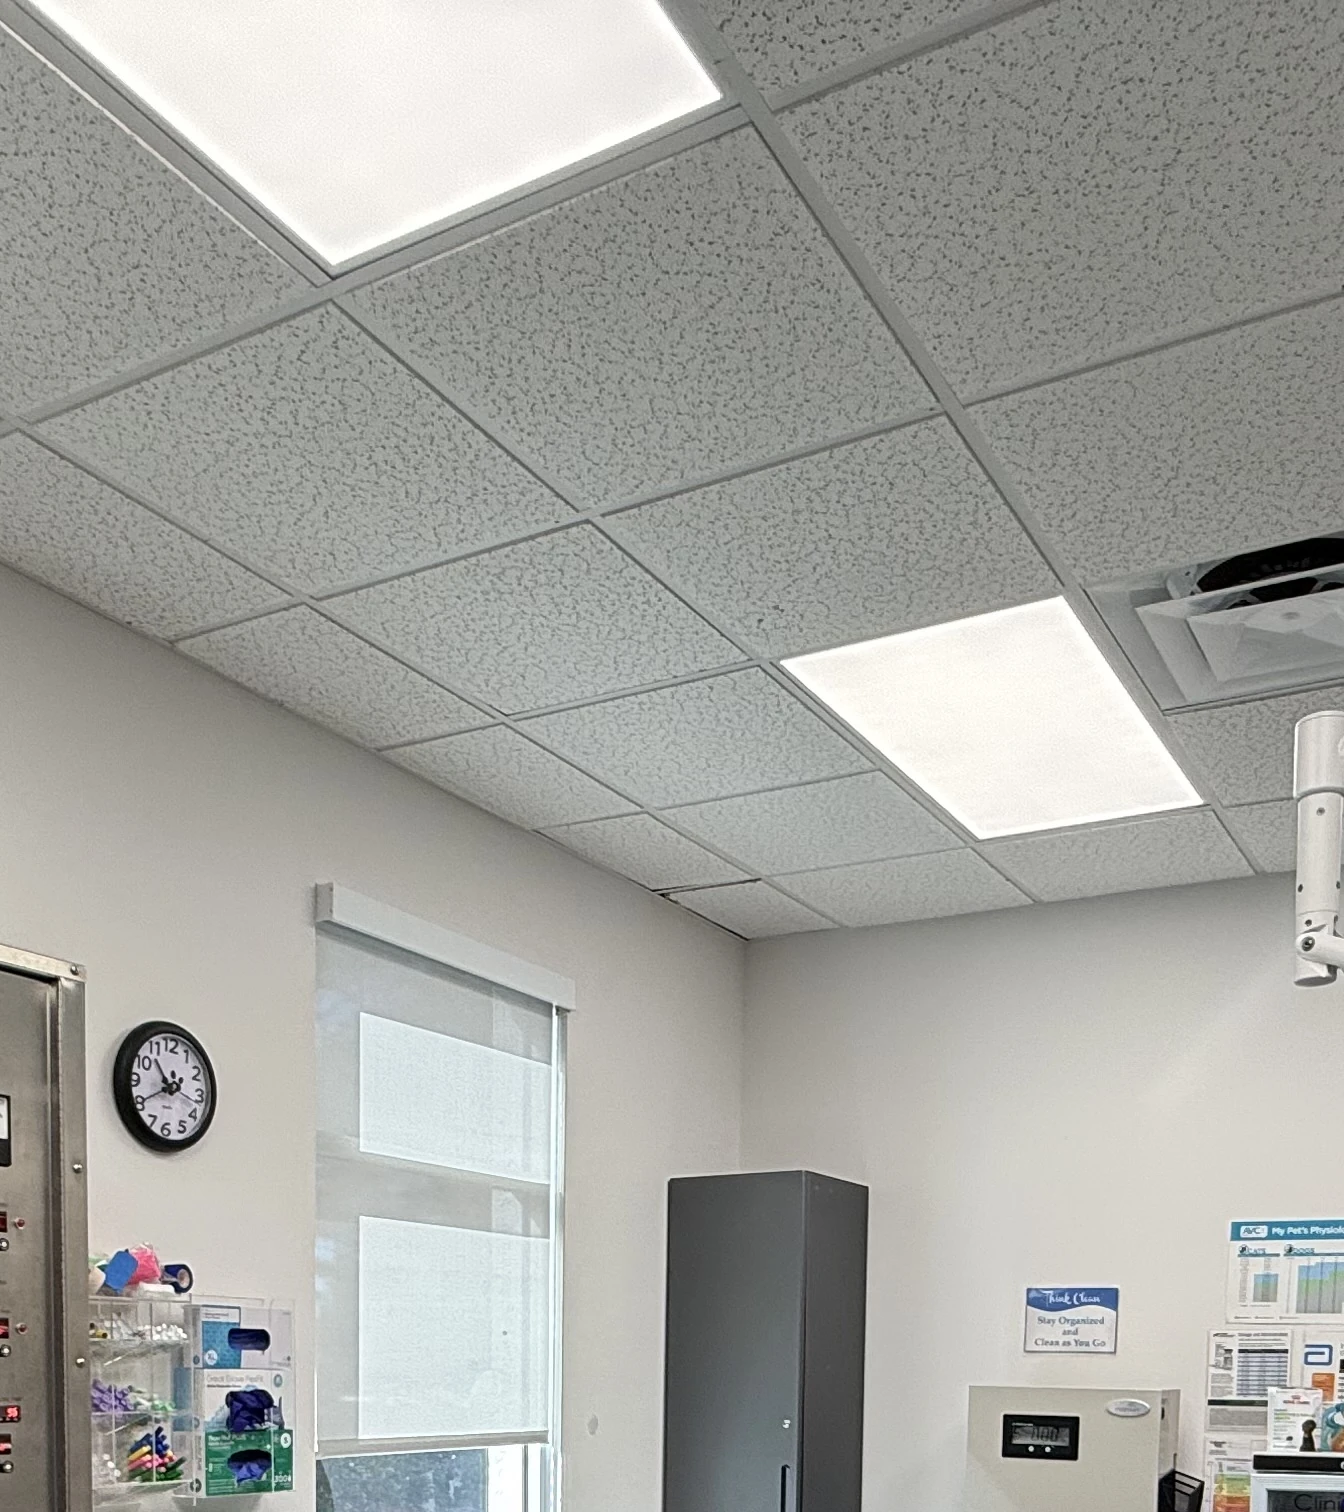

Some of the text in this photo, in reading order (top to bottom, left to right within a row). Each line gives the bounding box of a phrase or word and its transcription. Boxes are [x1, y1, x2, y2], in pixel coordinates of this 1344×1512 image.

[149, 1041, 161, 1056] 11
[162, 1038, 179, 1055] 12
[136, 1054, 152, 1071] 10
[183, 1049, 190, 1064] 1
[130, 1072, 141, 1087] 9
[191, 1065, 202, 1082] 2
[134, 1095, 145, 1111] 8
[194, 1088, 205, 1104] 3
[147, 1114, 158, 1128] 7
[188, 1107, 198, 1122] 4
[160, 1122, 172, 1137] 6
[177, 1120, 187, 1134] 5
[1271, 1226, 1284, 1237] My
[1286, 1226, 1309, 1235] Pet's
[1040, 1290, 1101, 1307] Think Clean
[1037, 1316, 1105, 1327] Stay Organized
[1062, 1328, 1079, 1336] and
[1034, 1338, 1106, 1347] Clean as You Go
